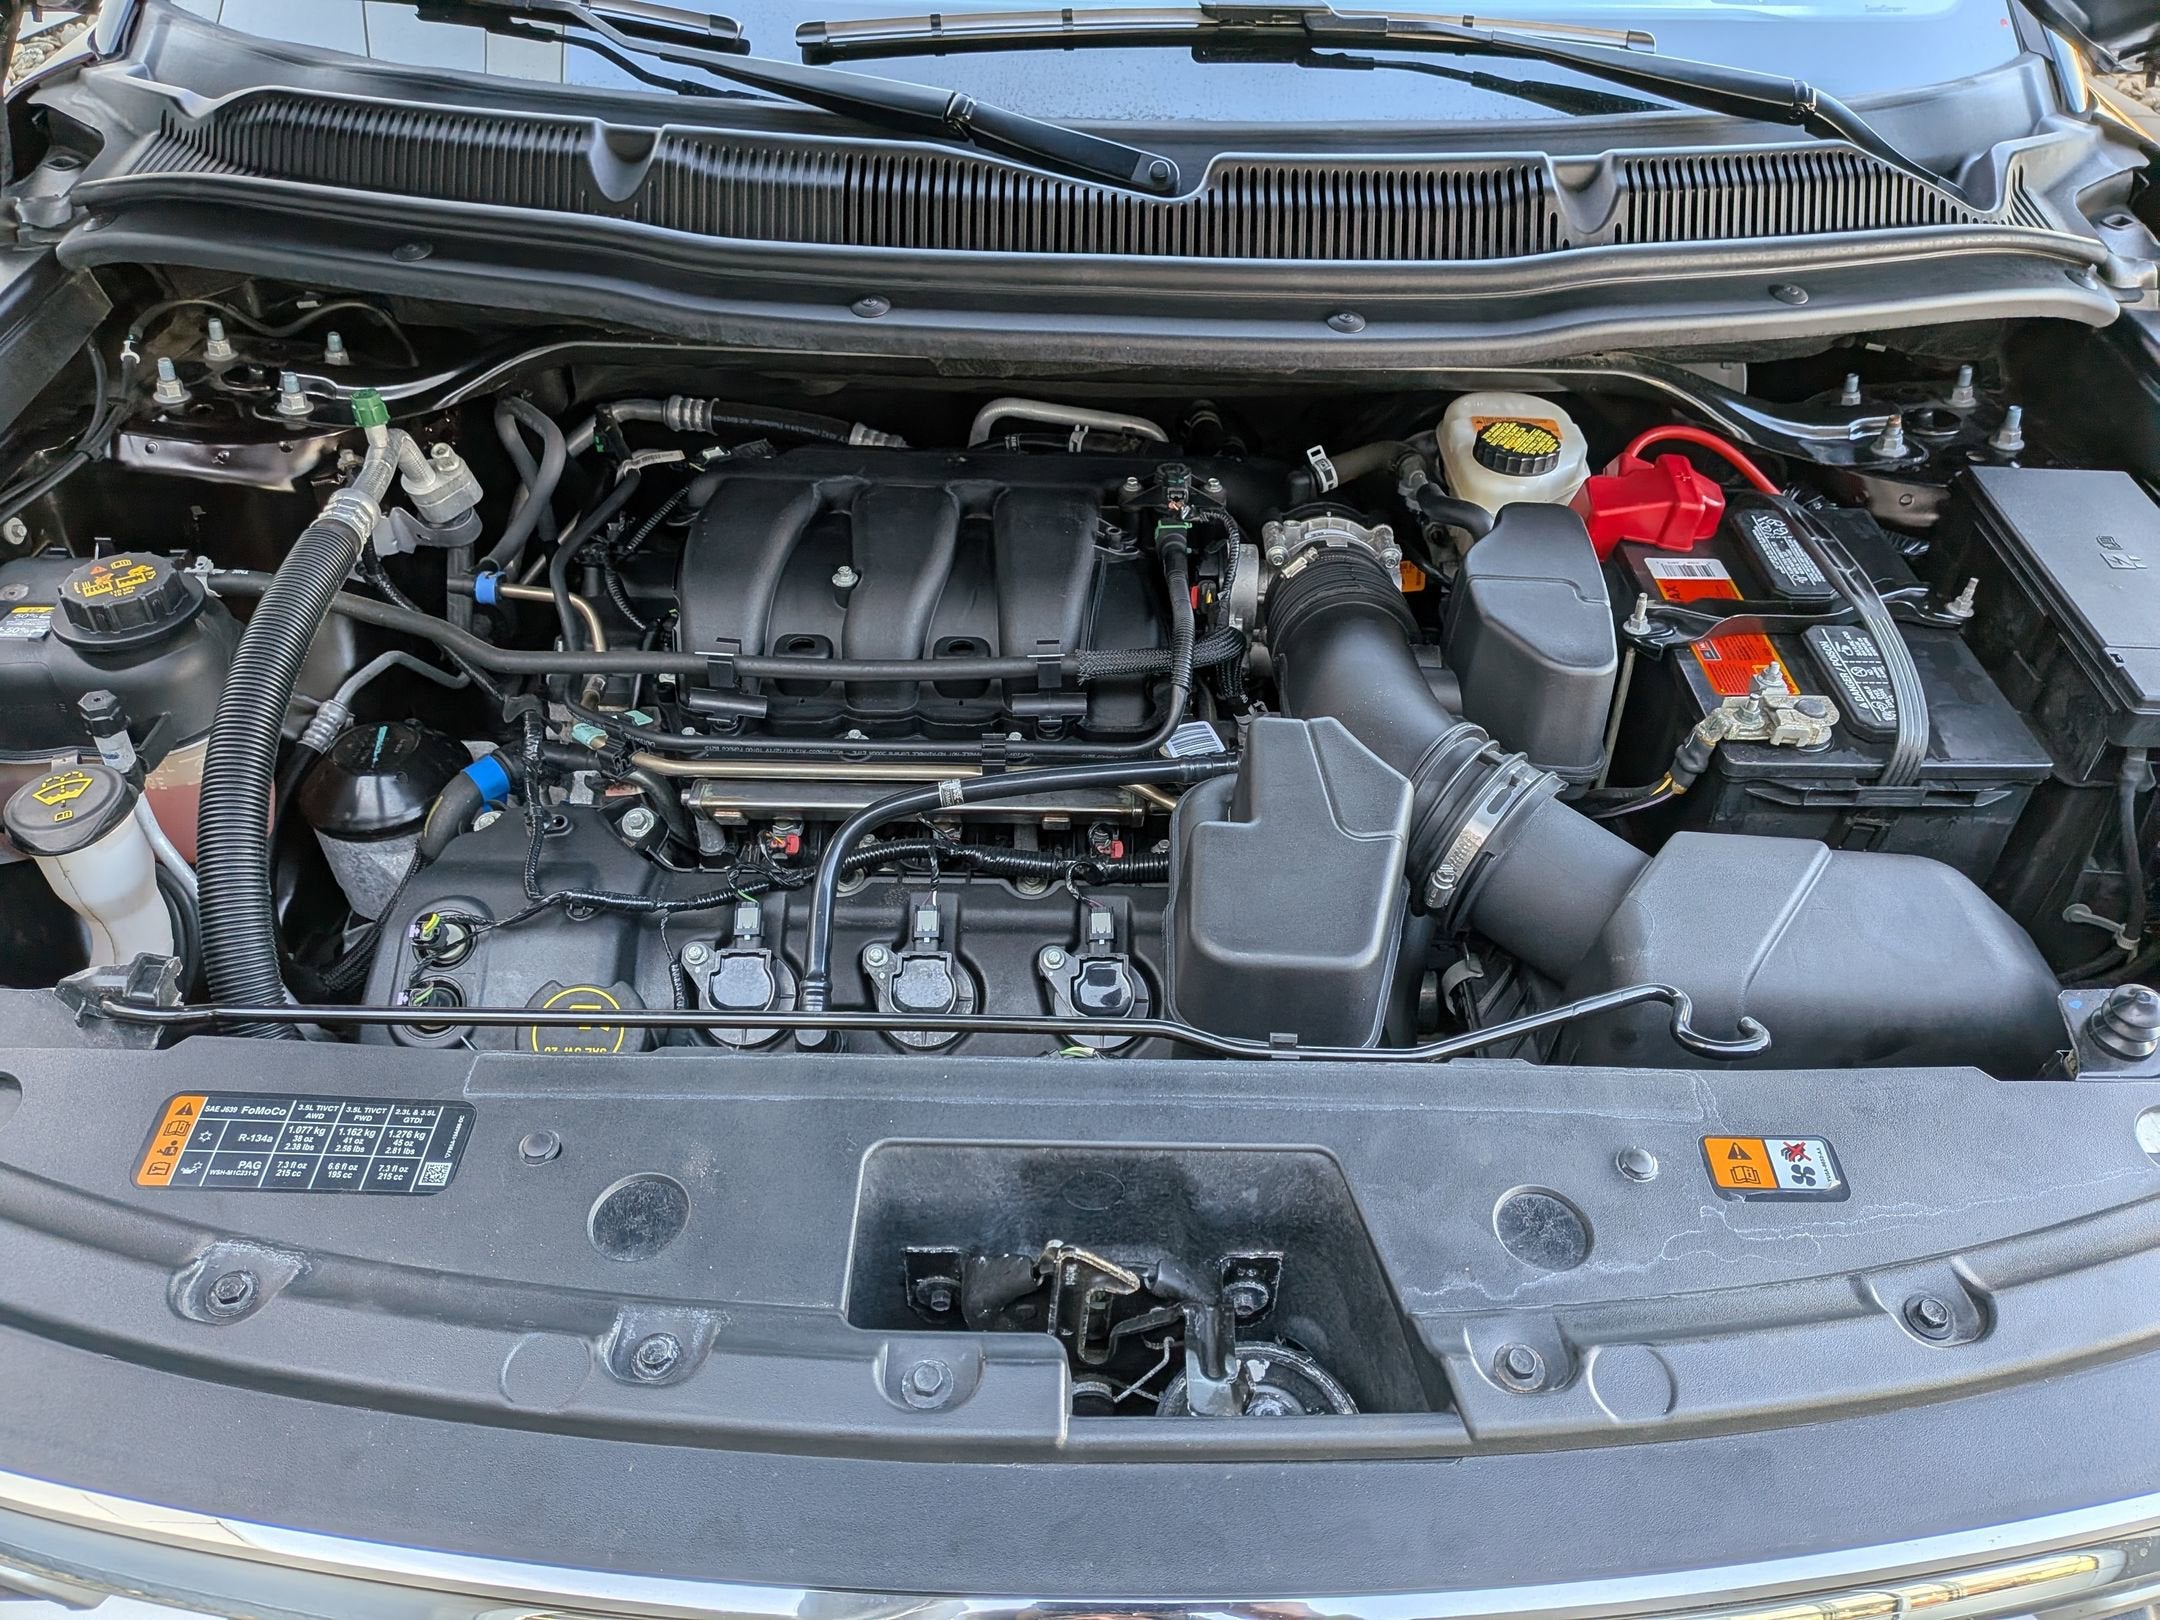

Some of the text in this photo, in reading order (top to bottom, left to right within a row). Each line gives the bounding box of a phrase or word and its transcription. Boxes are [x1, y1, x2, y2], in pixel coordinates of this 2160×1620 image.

[1819, 641, 1842, 667] POISON
[1840, 672, 1865, 702] DANGER
[241, 1106, 286, 1116] FoMoCo
[288, 1126, 326, 1136] 1.077 kg
[339, 1127, 376, 1138] 1.162 kg
[388, 1129, 426, 1141] 1.276 kg
[238, 1132, 274, 1143] R-134a
[284, 1142, 315, 1151] 2.38 lbs
[334, 1144, 365, 1153] 2.56 lbs
[384, 1146, 415, 1155] 2.81 lbs
[238, 1160, 262, 1169] PAG
[277, 1161, 289, 1169] 7.3
[290, 1161, 297, 1169] fl
[327, 1162, 340, 1170] 6.6
[341, 1163, 347, 1171] fl
[378, 1164, 391, 1172] 7.3
[275, 1169, 291, 1177] 215
